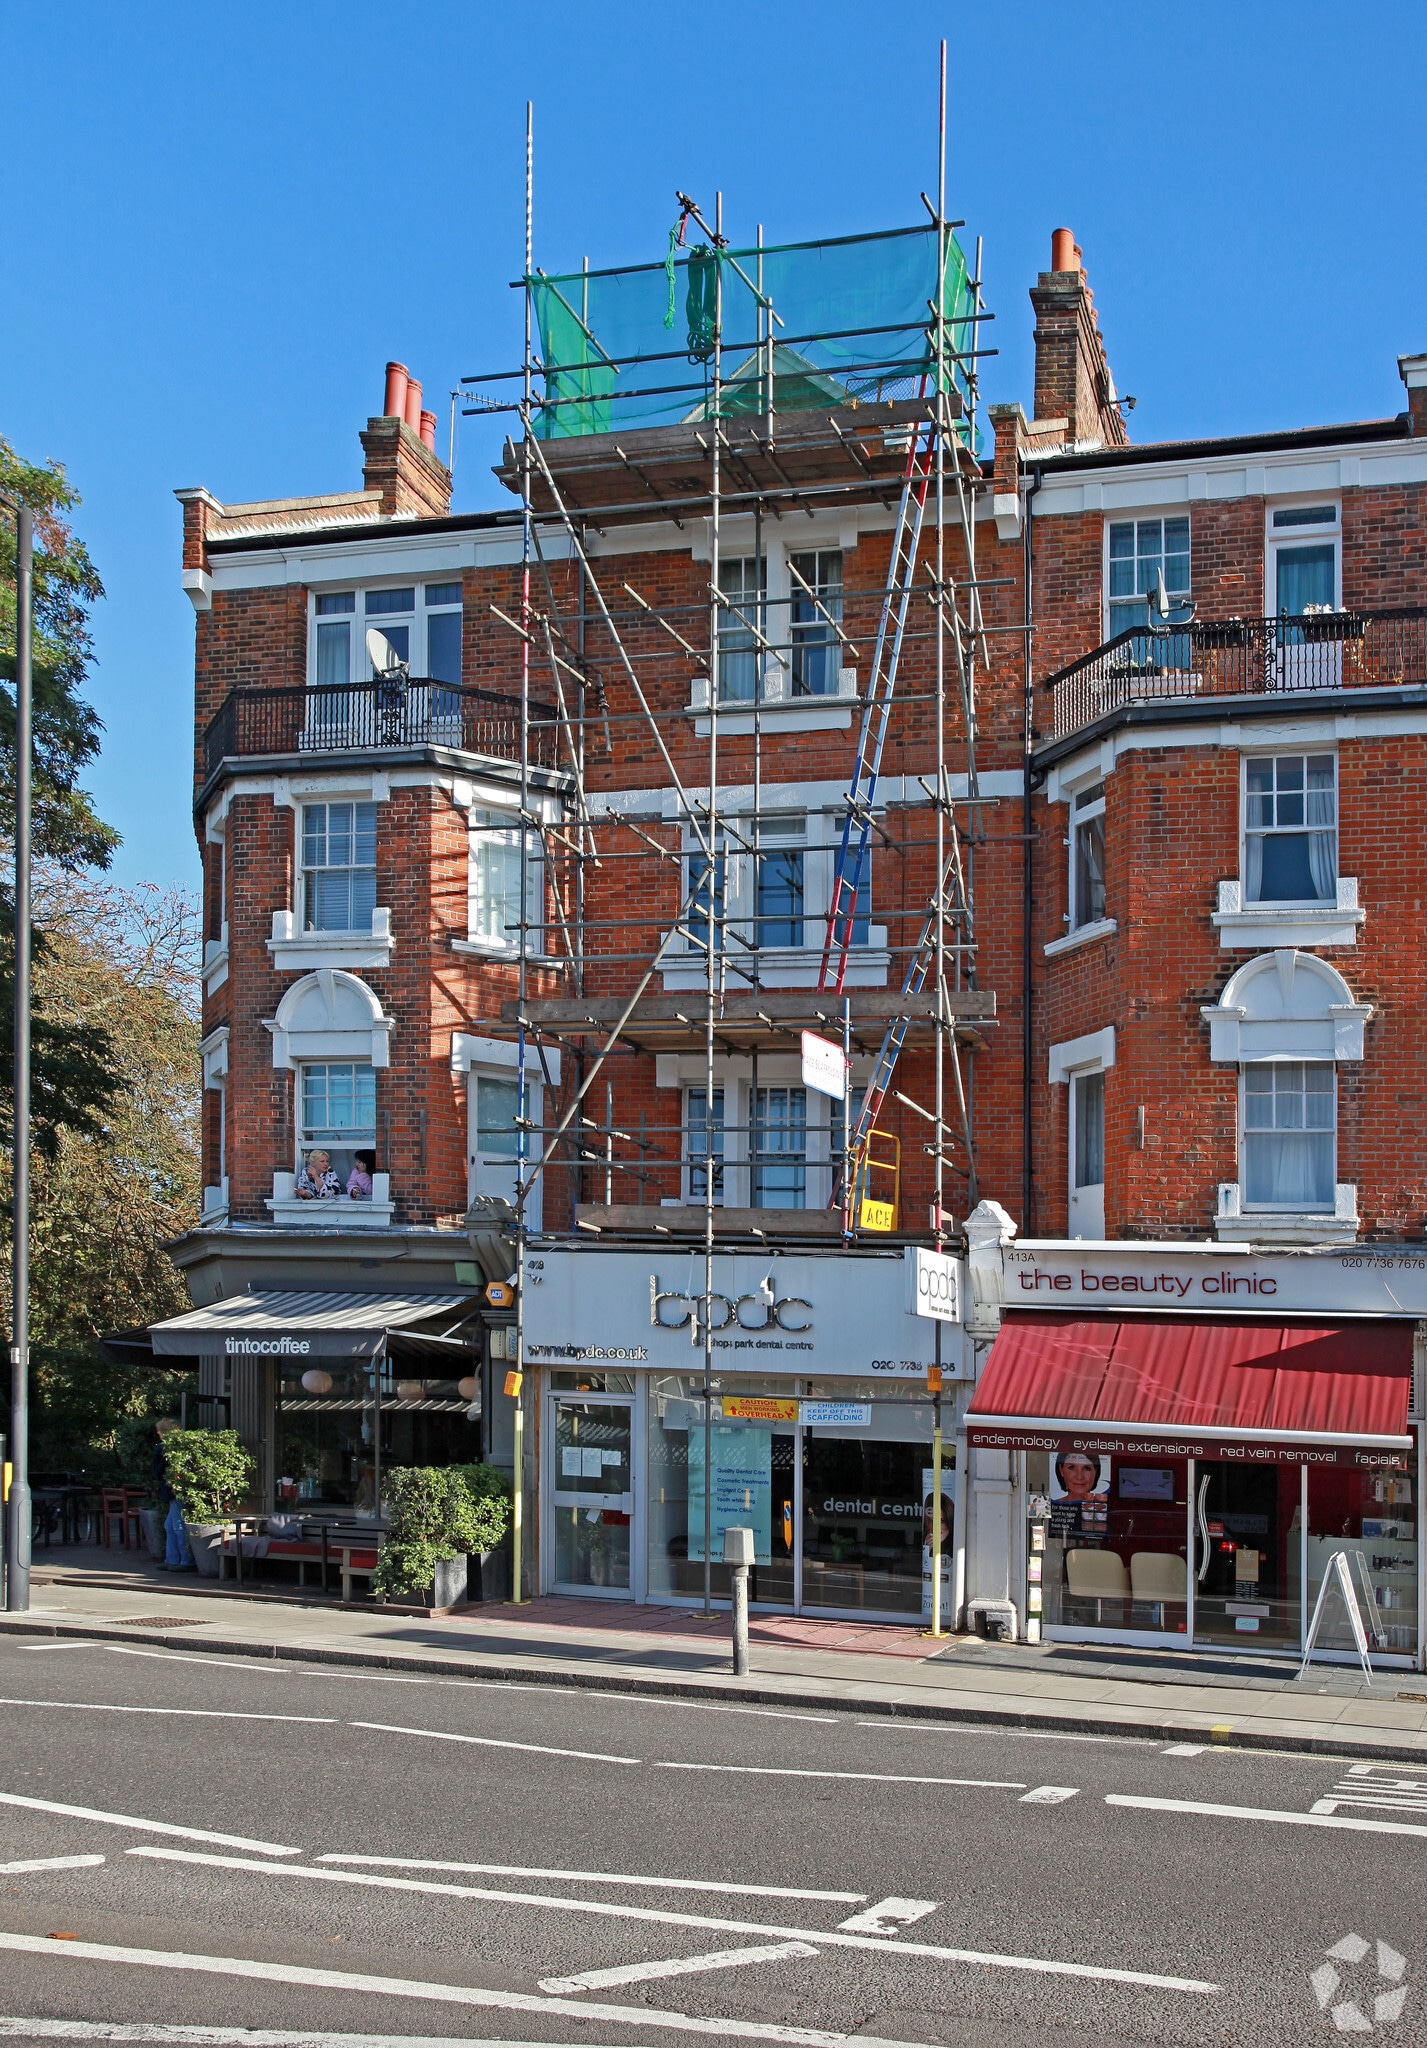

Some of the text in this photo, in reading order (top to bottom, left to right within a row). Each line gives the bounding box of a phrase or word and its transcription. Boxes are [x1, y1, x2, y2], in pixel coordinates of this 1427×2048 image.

[867, 1207, 890, 1228] ACE
[1008, 1253, 1035, 1263] 413A
[1341, 1258, 1426, 1269] 020 7736 7676
[1018, 1269, 1277, 1297] the beauty clinic
[491, 1291, 503, 1299] ADT
[650, 1274, 814, 1346] bpdc
[225, 1336, 310, 1354] tintocoffee
[527, 1343, 648, 1360] www.bpdc.co.uk
[735, 1339, 753, 1349] park
[756, 1339, 783, 1349] dental
[786, 1341, 814, 1350] centre
[872, 1360, 896, 1370] 020
[739, 1399, 778, 1407] CAUTION
[738, 1410, 784, 1419] OVERHEAD
[972, 1434, 1400, 1465] endermology eyelash extensions red vein removal facials
[823, 1497, 933, 1517] dental centre
